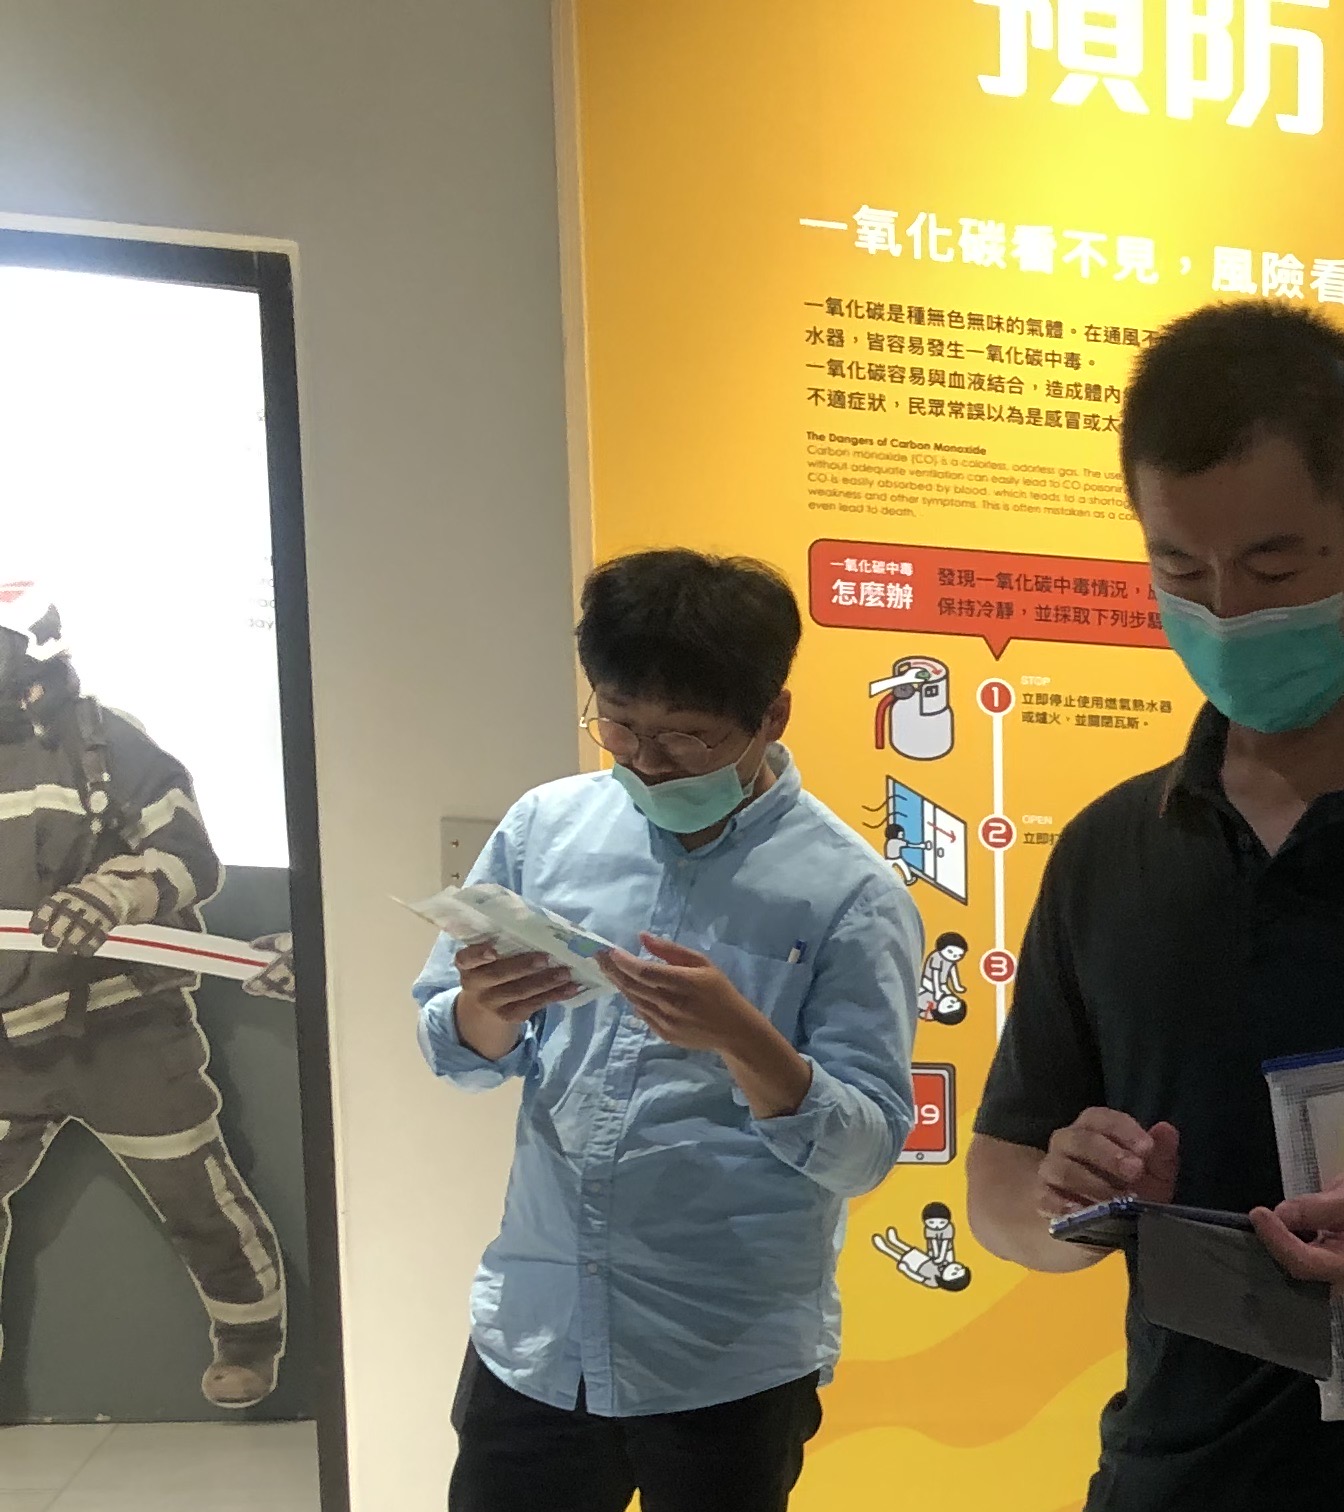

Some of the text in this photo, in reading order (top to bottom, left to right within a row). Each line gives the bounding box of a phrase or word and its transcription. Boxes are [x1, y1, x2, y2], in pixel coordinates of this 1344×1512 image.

[807, 431, 987, 455] The Dangers of Carbon Monoxide
[807, 445, 850, 457] Carbon
[853, 449, 908, 462] monoxide
[911, 454, 938, 466] (CO)
[1083, 467, 1101, 479] The
[807, 459, 848, 470] without
[851, 461, 906, 476] adequate
[909, 467, 965, 480] ventilation
[967, 474, 989, 483] can
[991, 474, 1019, 486] easily
[1022, 476, 1047, 487] lead
[1050, 478, 1061, 488] to
[1062, 479, 1081, 490] CO
[807, 471, 827, 483] CO
[830, 474, 839, 484] is
[842, 476, 875, 488] easily
[877, 478, 933, 491] absorbed
[936, 482, 950, 495] by
[994, 487, 1027, 499] which
[1030, 489, 1061, 501] leads
[1064, 493, 1075, 503] to
[1078, 496, 1086, 504] a
[808, 486, 862, 499] weakness
[864, 490, 888, 501] and
[890, 492, 919, 504] other
[982, 499, 1001, 511] This
[1012, 503, 1041, 514] often
[1043, 505, 1091, 517] mistaken
[1093, 510, 1105, 519] as
[808, 502, 836, 511] even
[839, 501, 864, 513] lead
[866, 504, 878, 514] to
[830, 558, 914, 576] 一氧化碳中毒
[831, 579, 914, 610] 怎麼辦
[1020, 675, 1051, 686] STOP
[1022, 814, 1053, 825] OPEN
[988, 823, 1008, 843] 2
[989, 956, 1009, 976] 3
